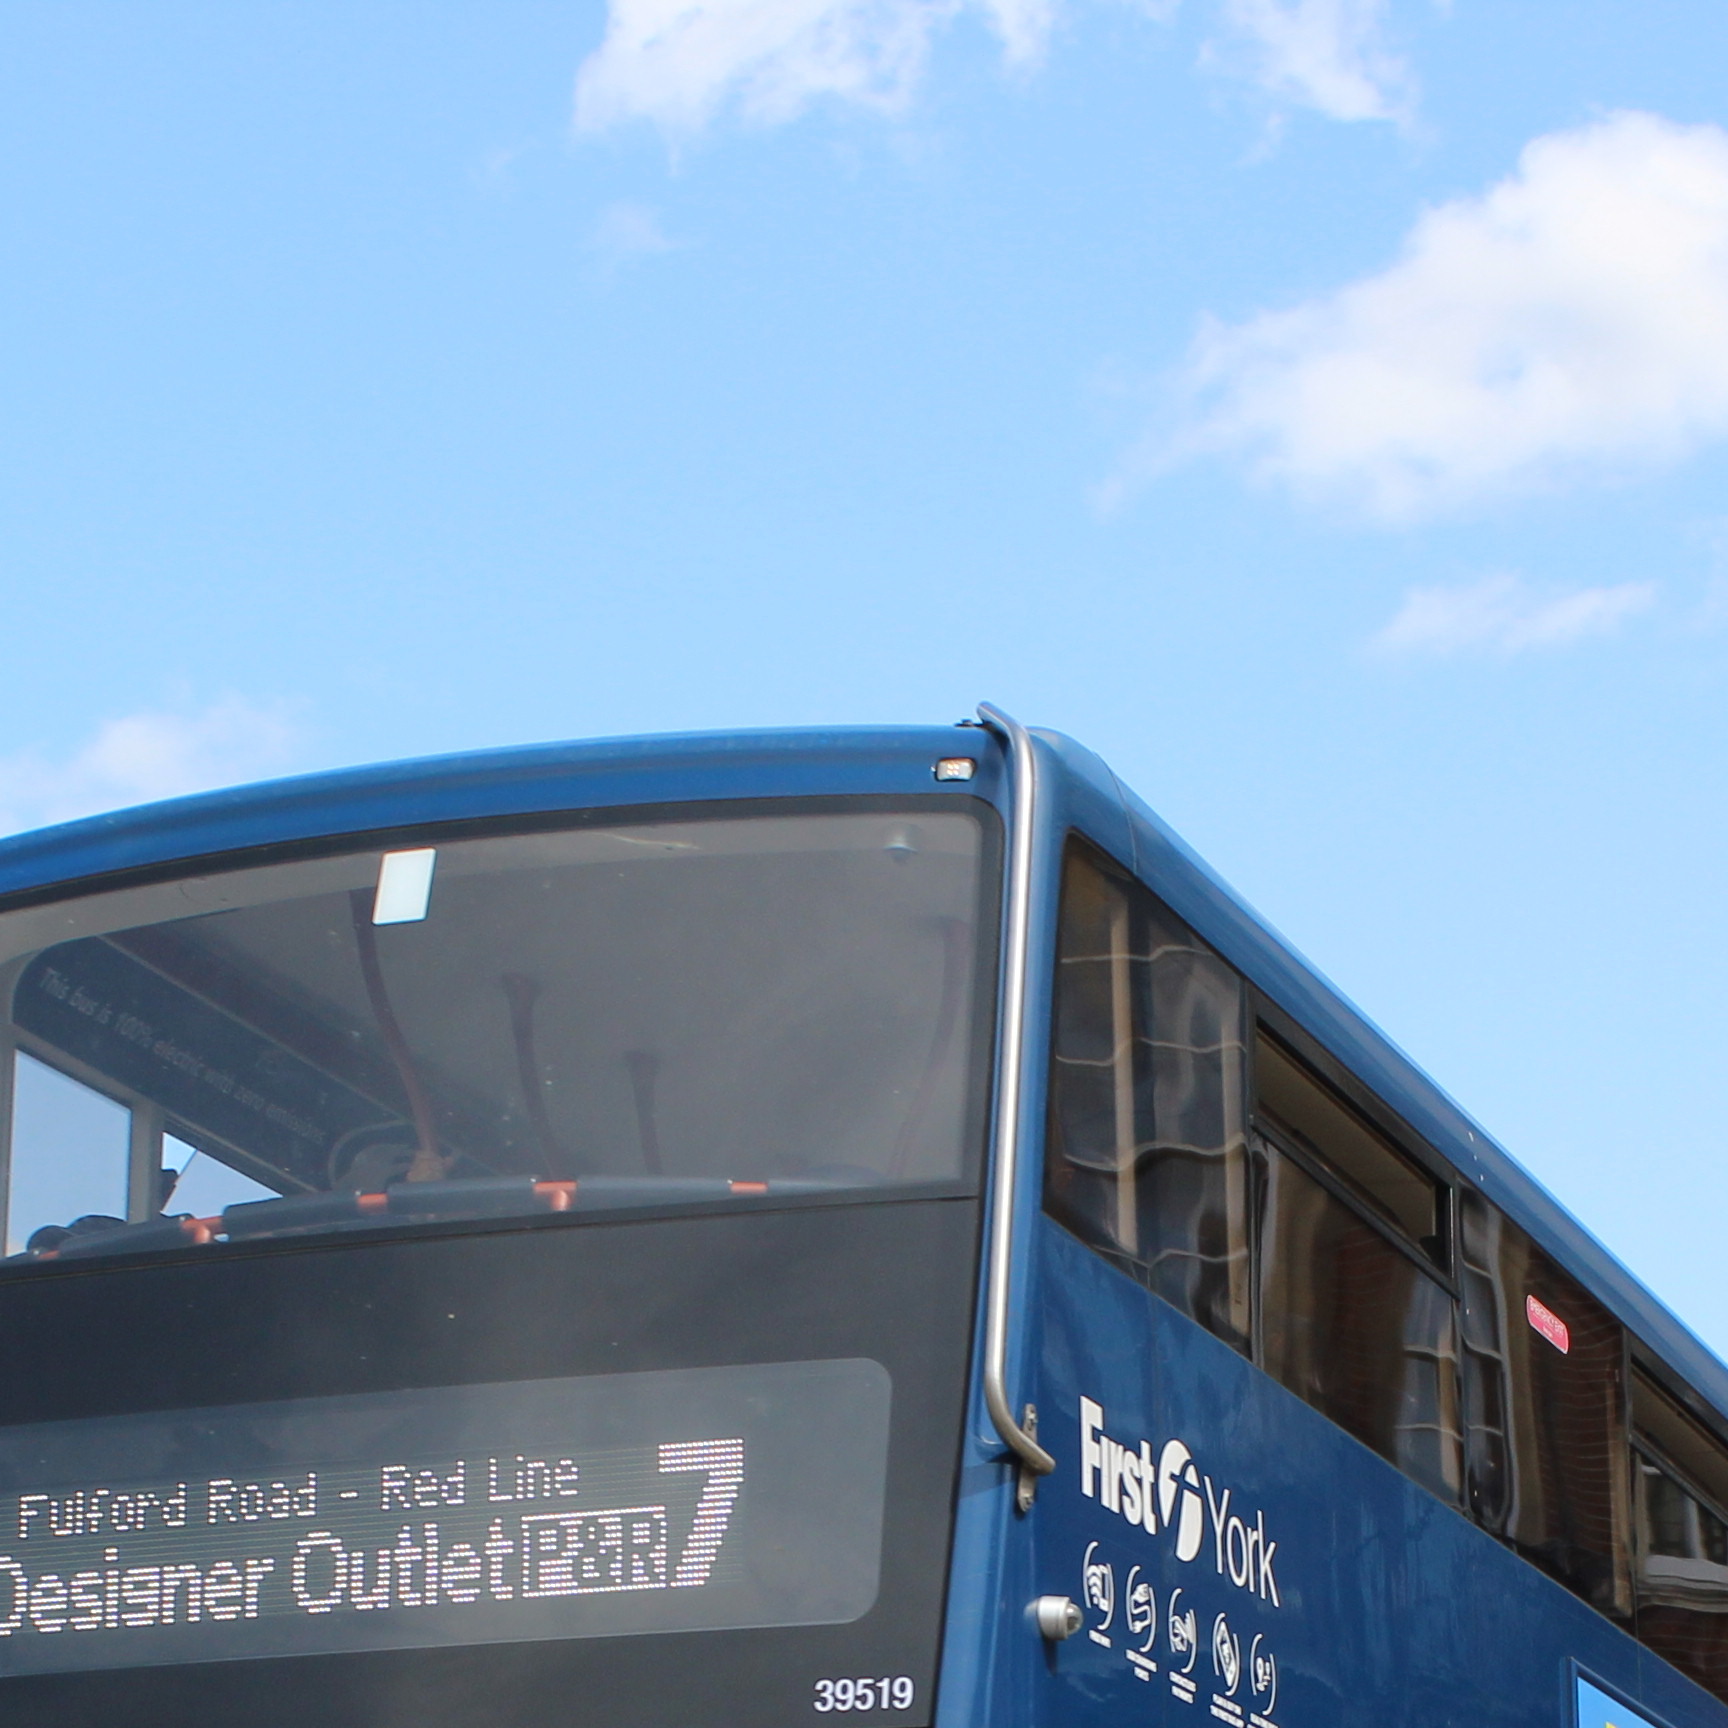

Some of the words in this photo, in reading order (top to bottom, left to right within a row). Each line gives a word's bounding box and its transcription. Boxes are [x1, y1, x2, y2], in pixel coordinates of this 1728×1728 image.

[16, 1483, 188, 1541] Fulford
[207, 1471, 319, 1523] Road
[381, 1462, 467, 1513] Red
[487, 1452, 581, 1506] Line
[656, 1437, 745, 1589] 7
[1079, 1395, 1157, 1536] First
[1203, 1475, 1280, 1608] York
[290, 1512, 517, 1617] Outlet
[812, 1676, 914, 1714] 39519
